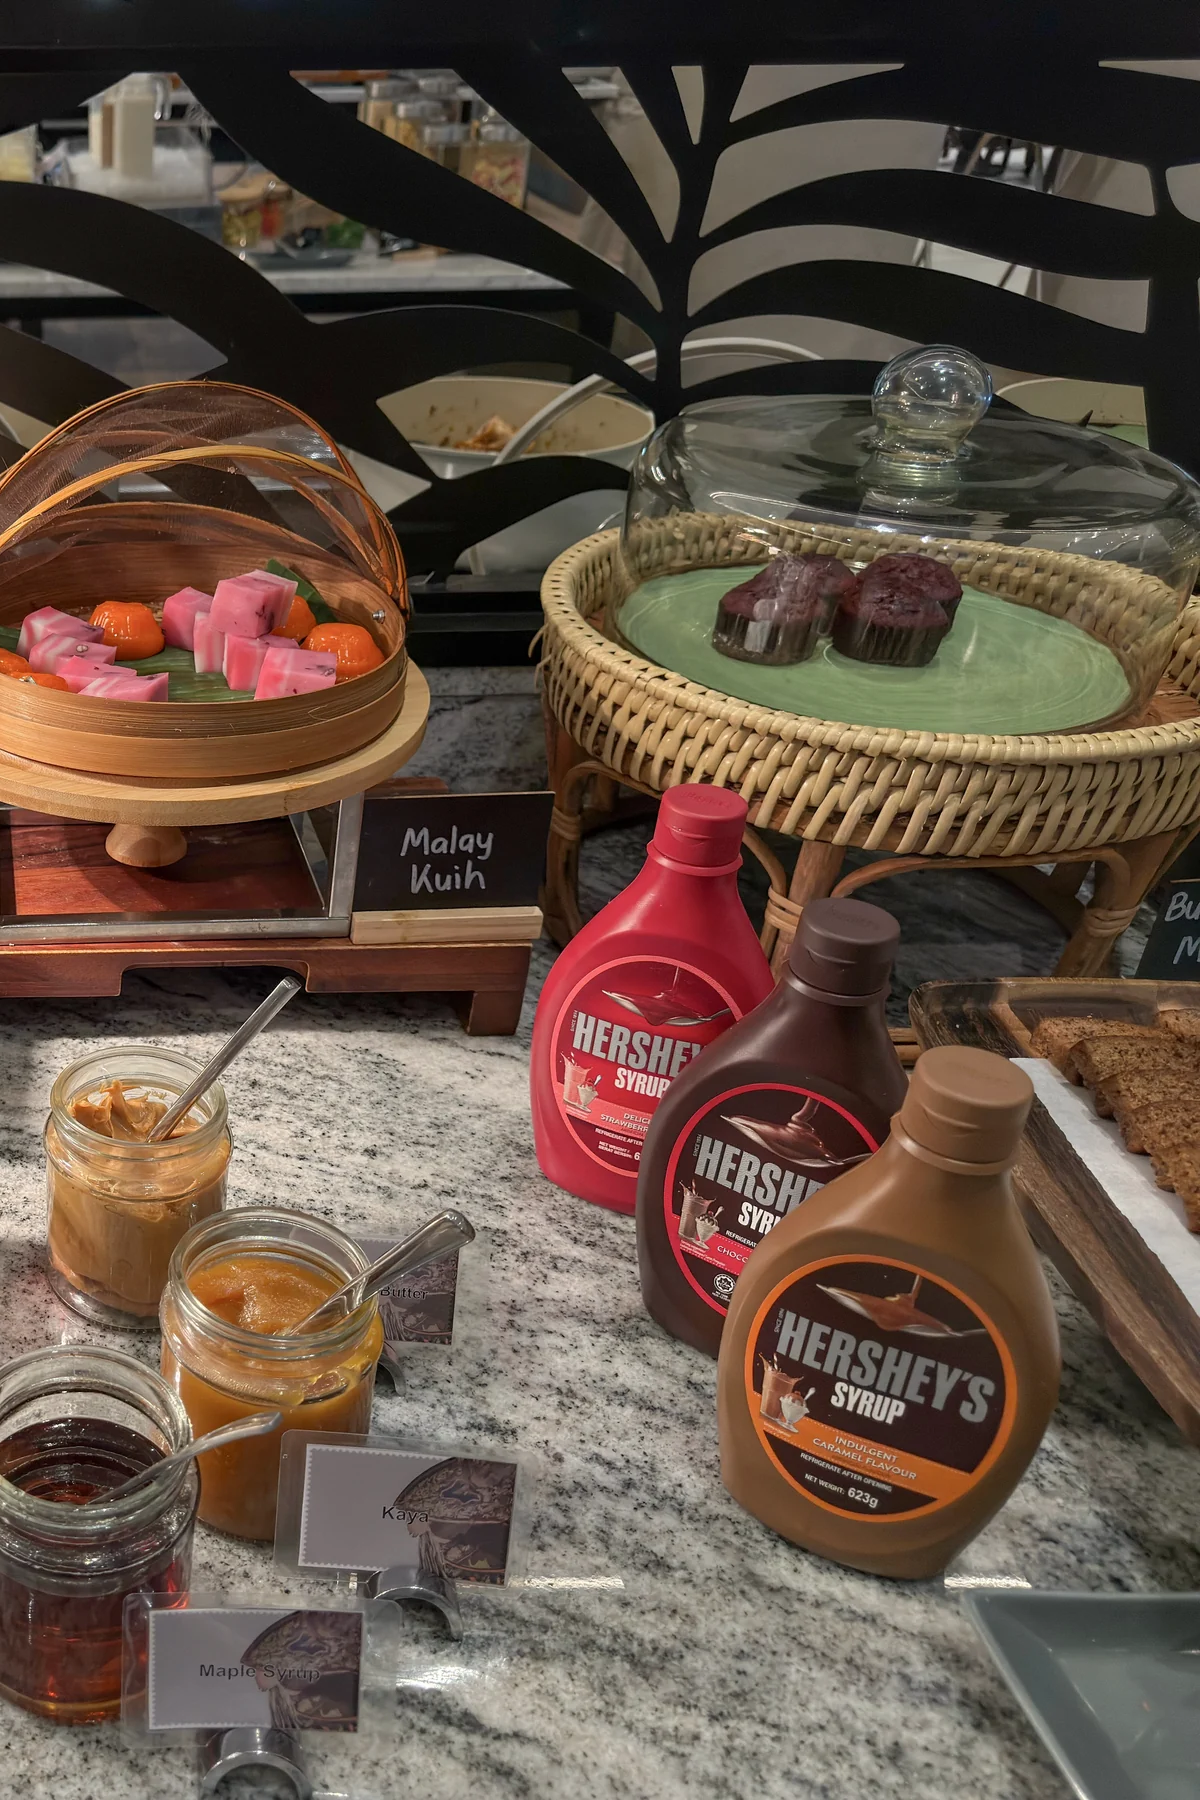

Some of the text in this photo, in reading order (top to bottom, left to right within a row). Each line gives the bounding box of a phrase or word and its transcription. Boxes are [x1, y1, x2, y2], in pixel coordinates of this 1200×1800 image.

[400, 825, 494, 860] Malay
[411, 859, 486, 894] Kuih
[627, 1138, 643, 1146] AFTER
[380, 1286, 428, 1300] Butter
[775, 1310, 996, 1423] HERSHEY'S
[831, 1382, 906, 1424] SYRUP
[812, 1438, 863, 1462] CARAMEL
[865, 1457, 917, 1480] FLAVOUR
[835, 1436, 898, 1463] INDULGENT
[800, 1452, 842, 1473] REFRIGERATE
[842, 1470, 862, 1482] AFTER
[863, 1477, 893, 1492] OPENING
[804, 1473, 818, 1483] NET
[847, 1487, 879, 1508] 623g
[382, 1506, 429, 1524] Kaya
[199, 1664, 320, 1682] Maple Syrup
